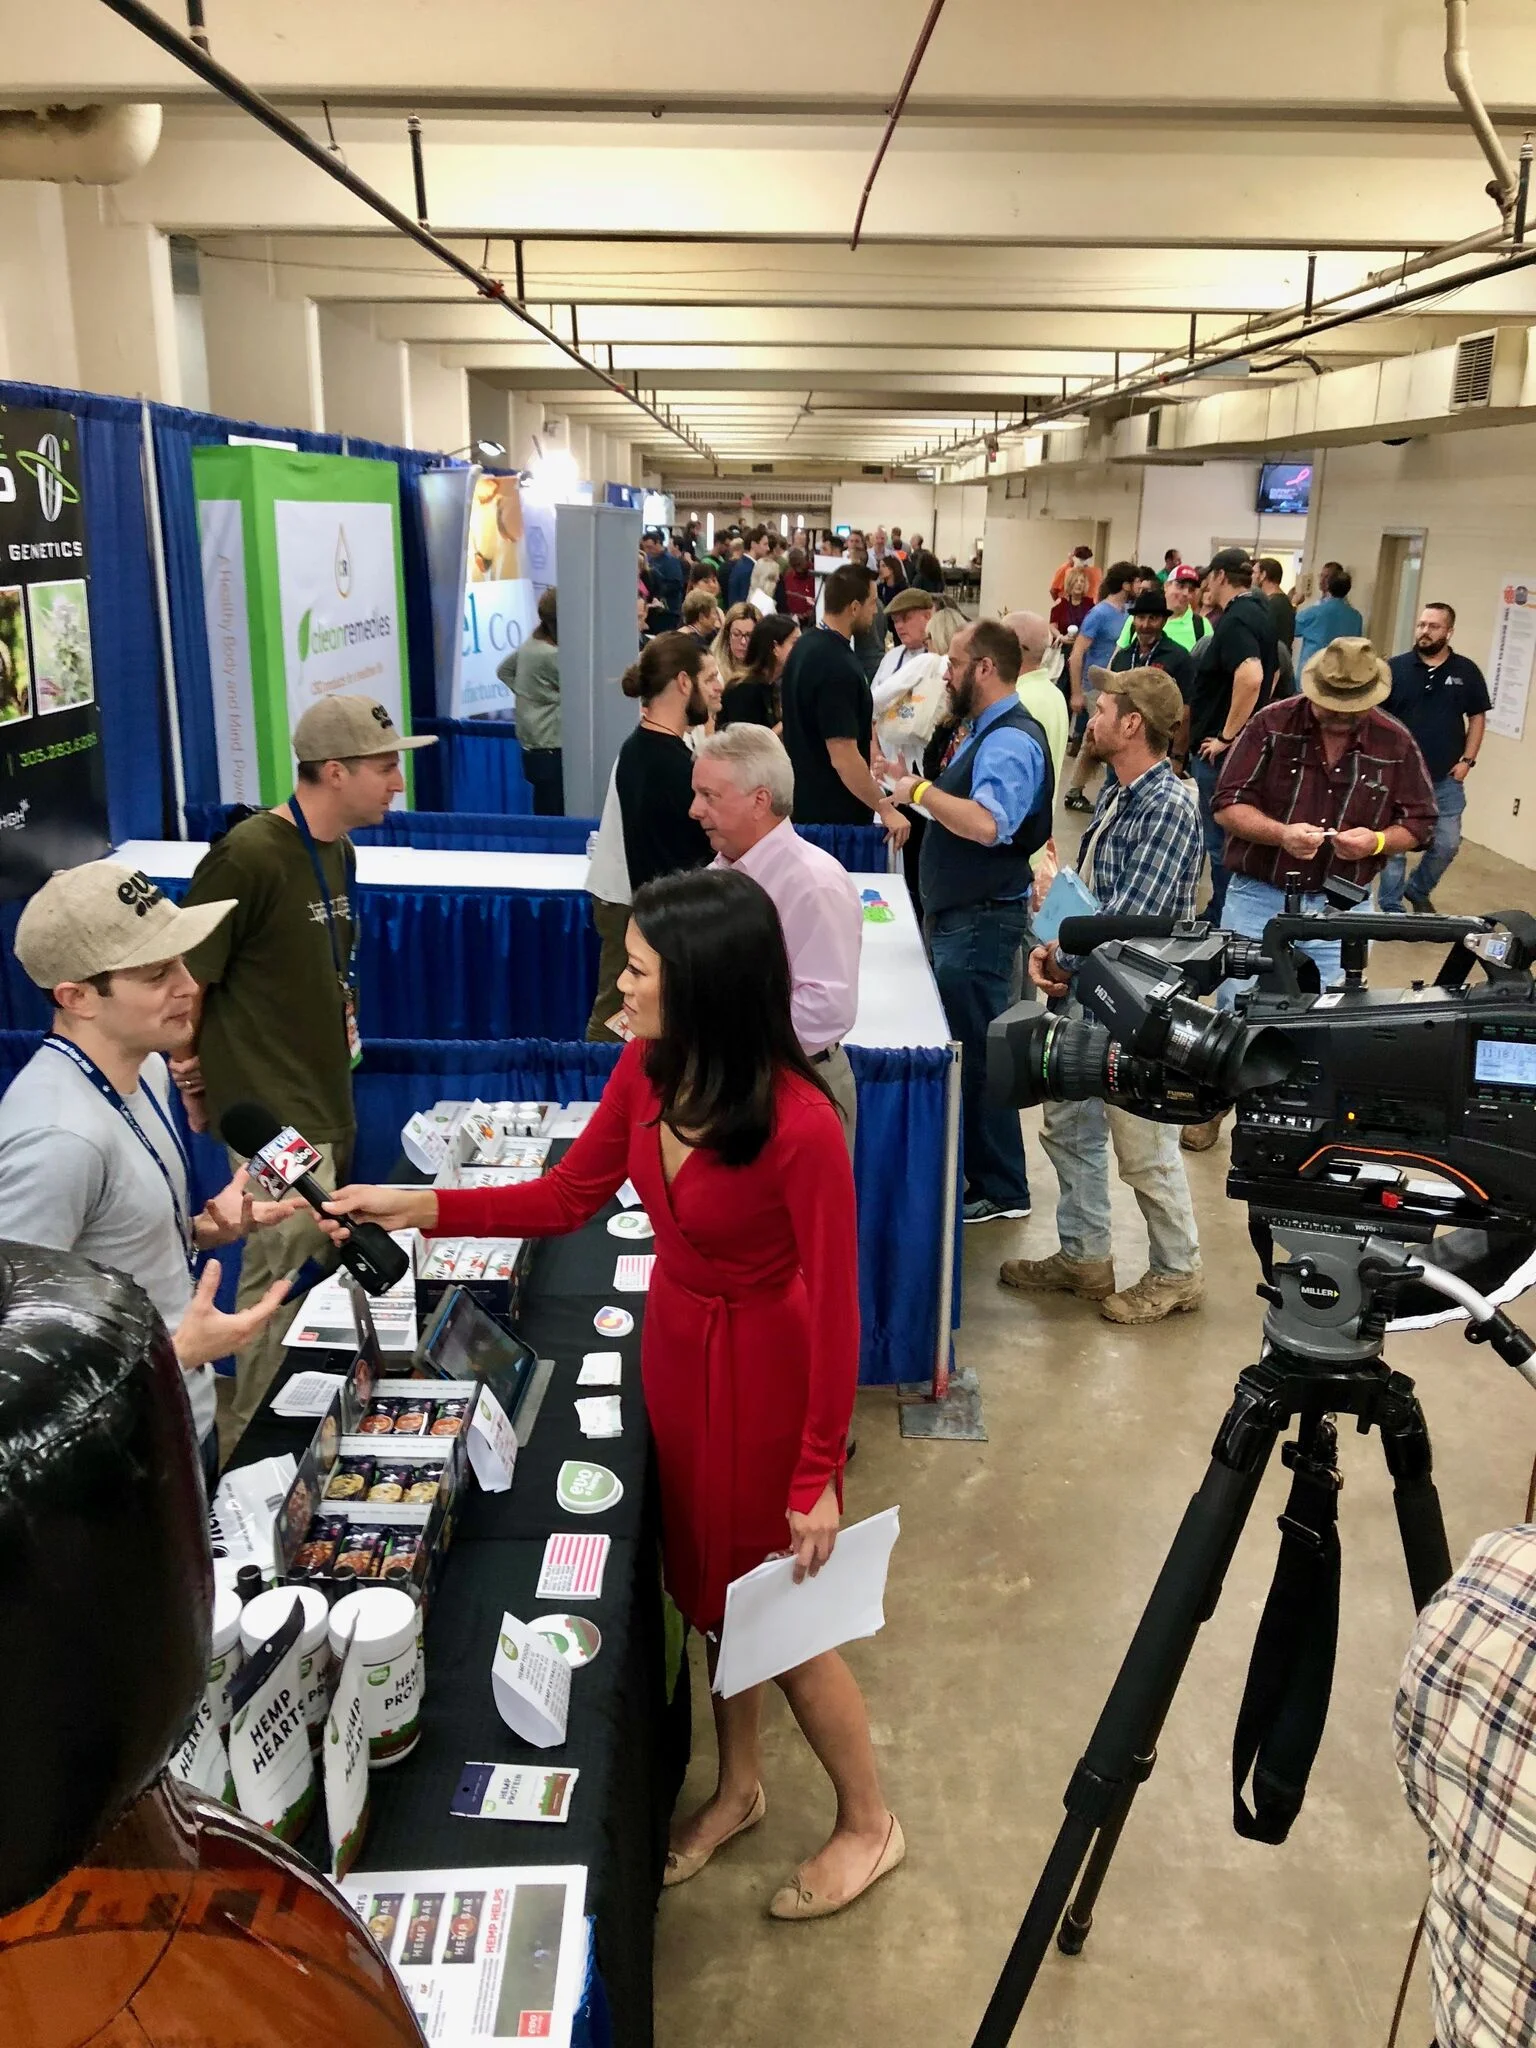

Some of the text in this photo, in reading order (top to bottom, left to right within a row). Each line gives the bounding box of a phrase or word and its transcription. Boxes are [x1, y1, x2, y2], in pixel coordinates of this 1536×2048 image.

[8, 541, 83, 561] GENETICS
[217, 569, 235, 632] Healthy
[223, 635, 235, 676] Body
[225, 679, 240, 710] and
[232, 759, 247, 803] Powe
[273, 1151, 308, 1184] 2
[294, 1148, 314, 1165] abc
[1301, 1286, 1334, 1297] MILLER
[250, 1688, 291, 1747] HEMP
[252, 1699, 306, 1775] HEARTS
[499, 1777, 512, 1800] HEMP
[507, 1773, 523, 1805] PROTEIN
[490, 1887, 505, 1921] HELPS
[412, 1899, 433, 1958] HEMP BAR
[454, 1897, 474, 1956] HEMP BAR
[485, 1923, 499, 1954] HEMP
